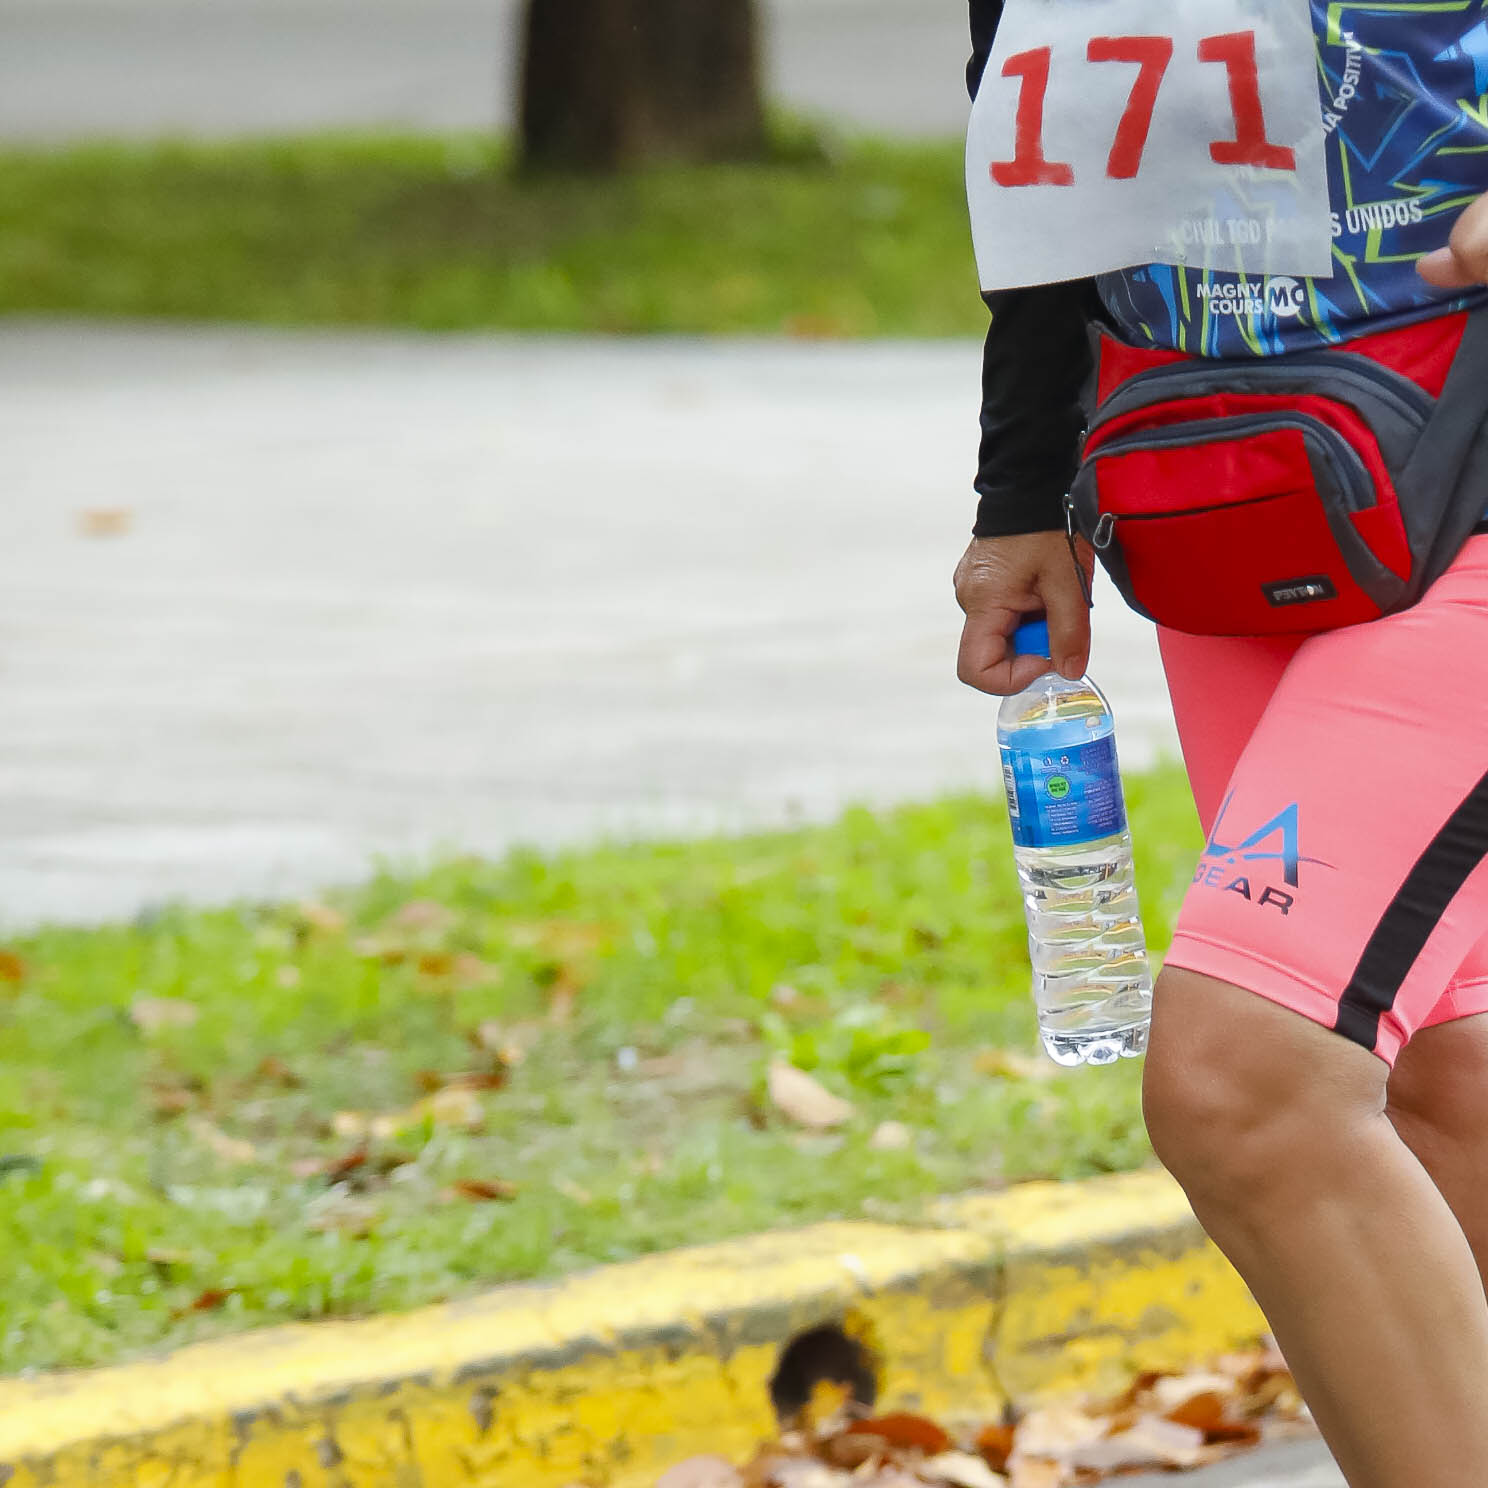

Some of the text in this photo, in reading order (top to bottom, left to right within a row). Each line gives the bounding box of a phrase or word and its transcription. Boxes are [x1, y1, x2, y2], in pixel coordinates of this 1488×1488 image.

[989, 30, 1296, 187] 171
[1346, 199, 1424, 234] UNIDOS
[1197, 283, 1261, 299] MAGNY
[1209, 299, 1264, 315] COURS
